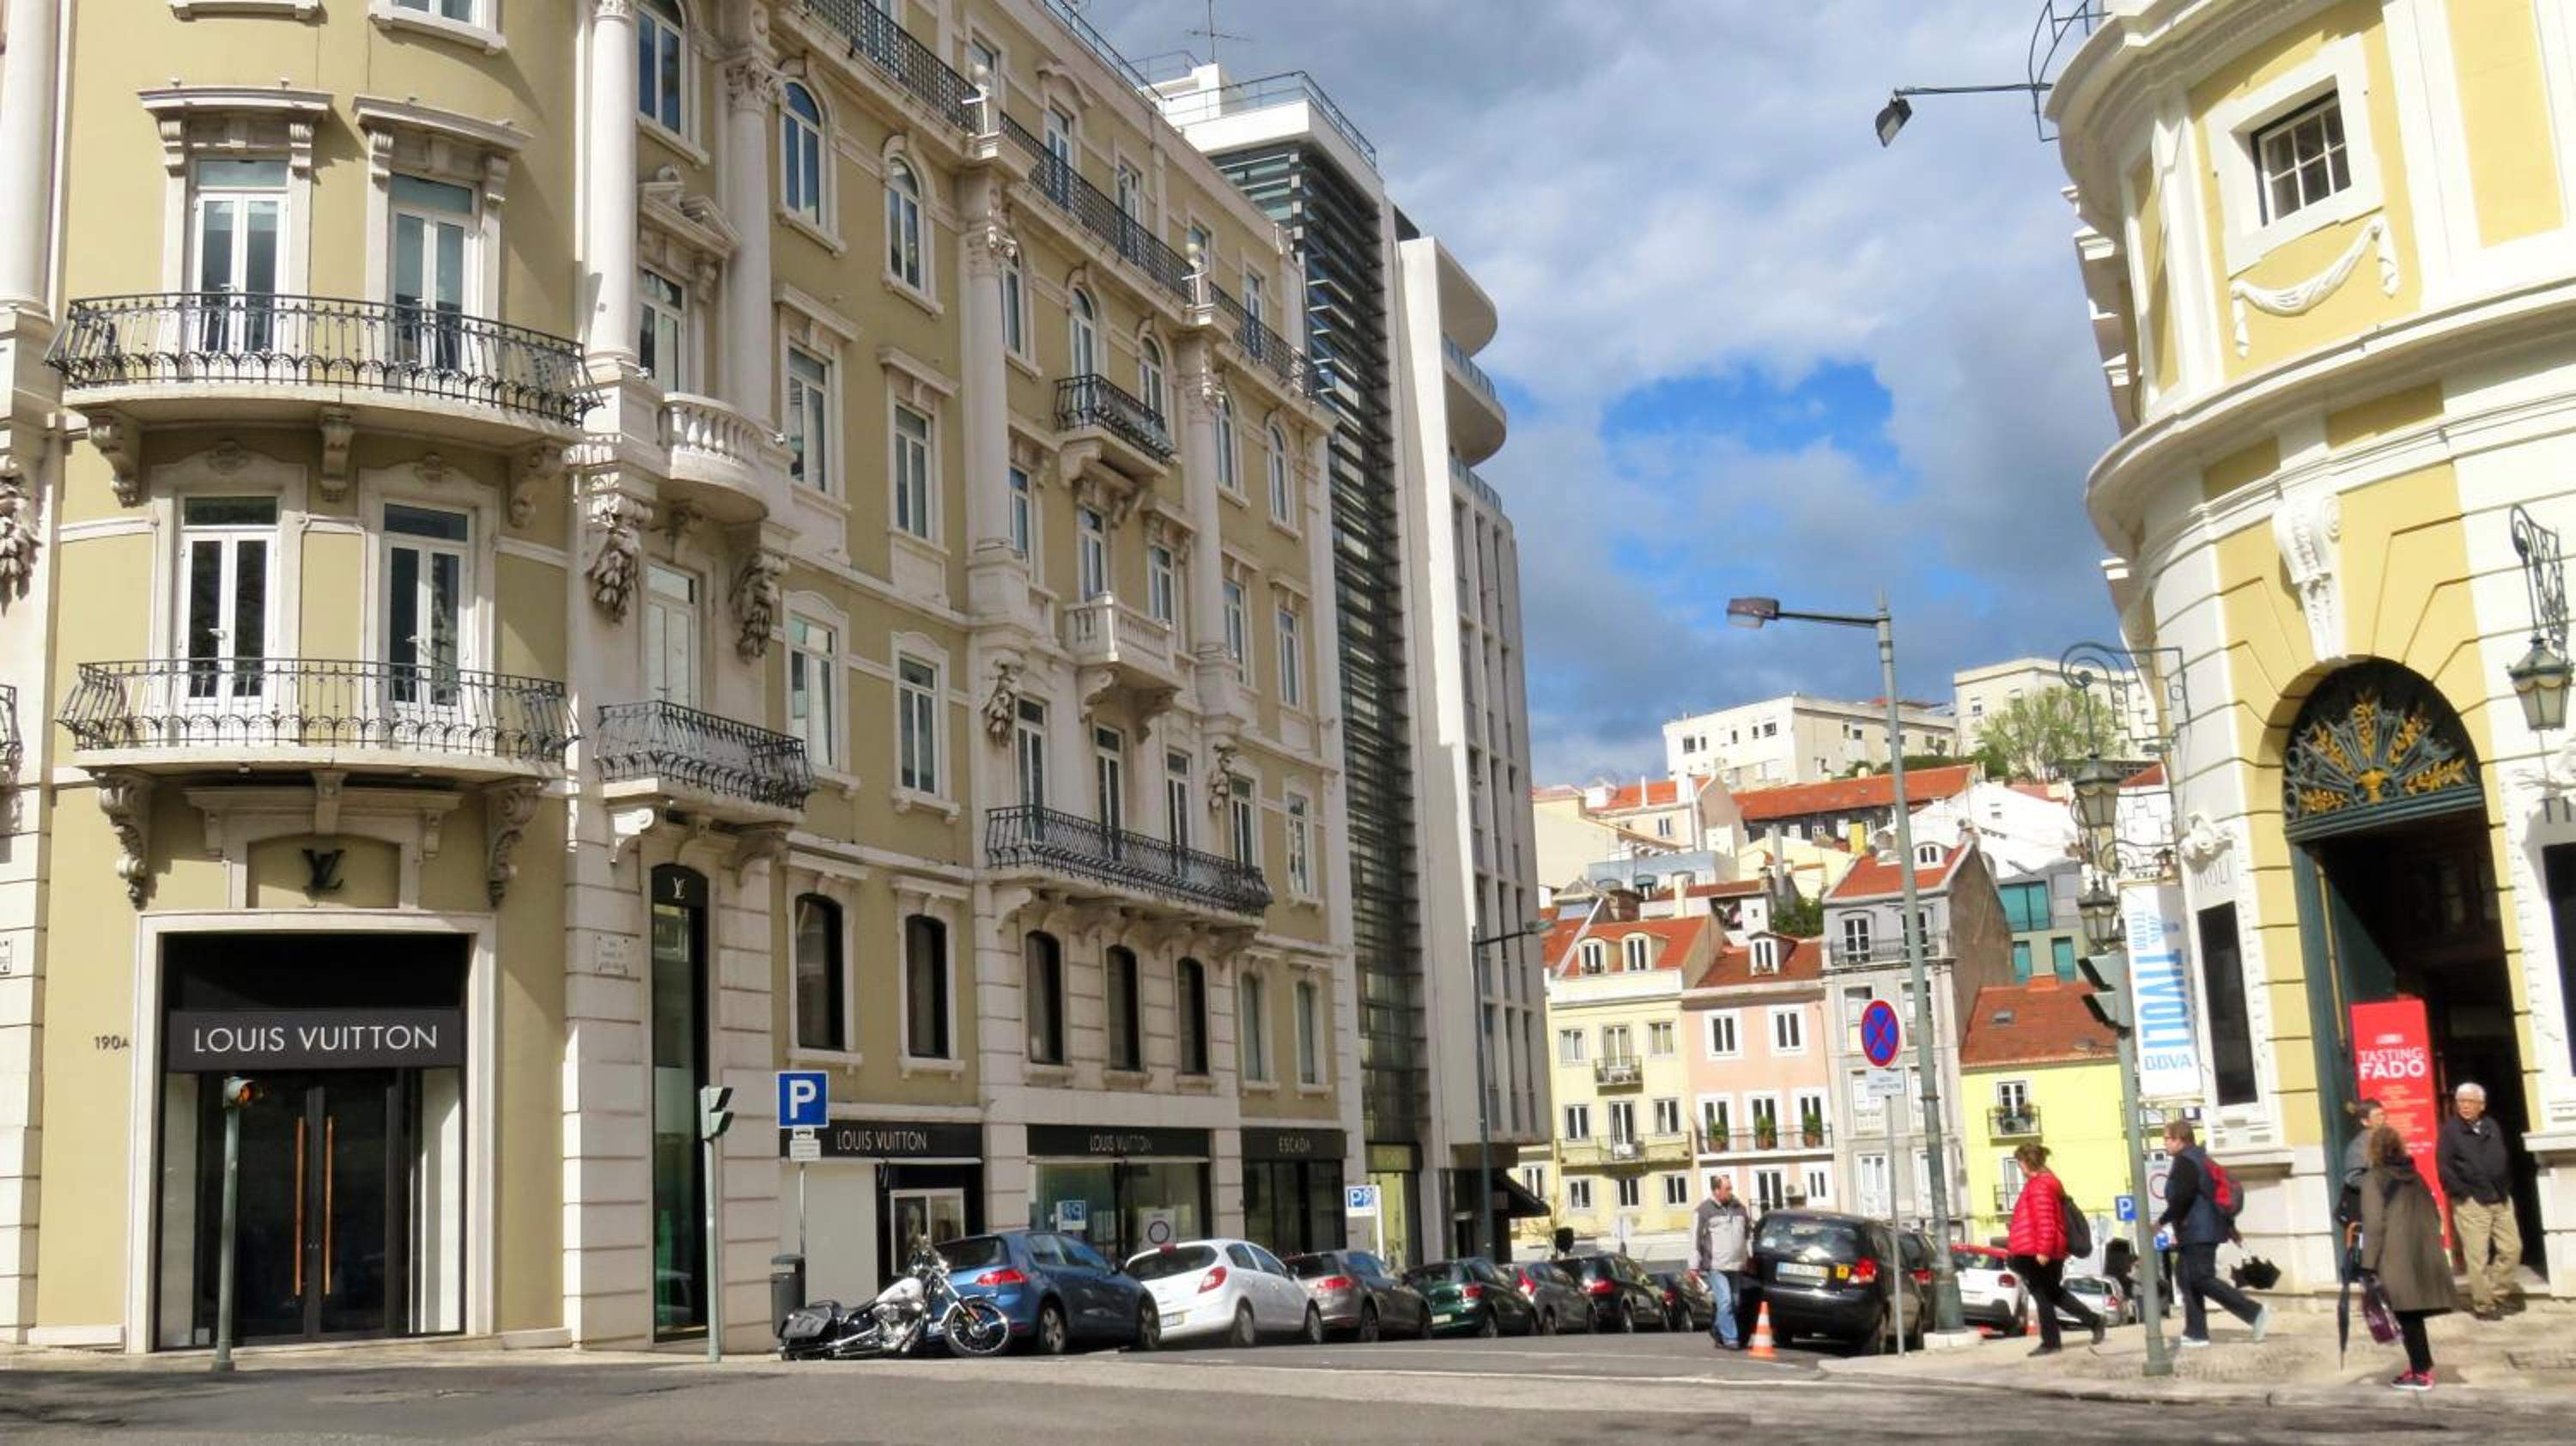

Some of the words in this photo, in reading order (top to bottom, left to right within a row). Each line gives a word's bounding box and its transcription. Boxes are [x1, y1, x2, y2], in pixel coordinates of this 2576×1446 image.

[2135, 948, 2191, 1049] TIVOLI
[194, 1027, 285, 1052] LOUIS
[298, 1025, 438, 1051] VUITTON
[2144, 1054, 2192, 1071] BBVA
[2360, 1048, 2425, 1063] TASTING
[2360, 1059, 2426, 1080] FADO
[789, 1079, 817, 1120] P
[837, 1130, 873, 1151] LOUIS
[875, 1131, 928, 1151] VUITTON
[1090, 1133, 1114, 1151] LOUIS
[1278, 1135, 1311, 1153] ESCADA
[2118, 1198, 2133, 1219] P
